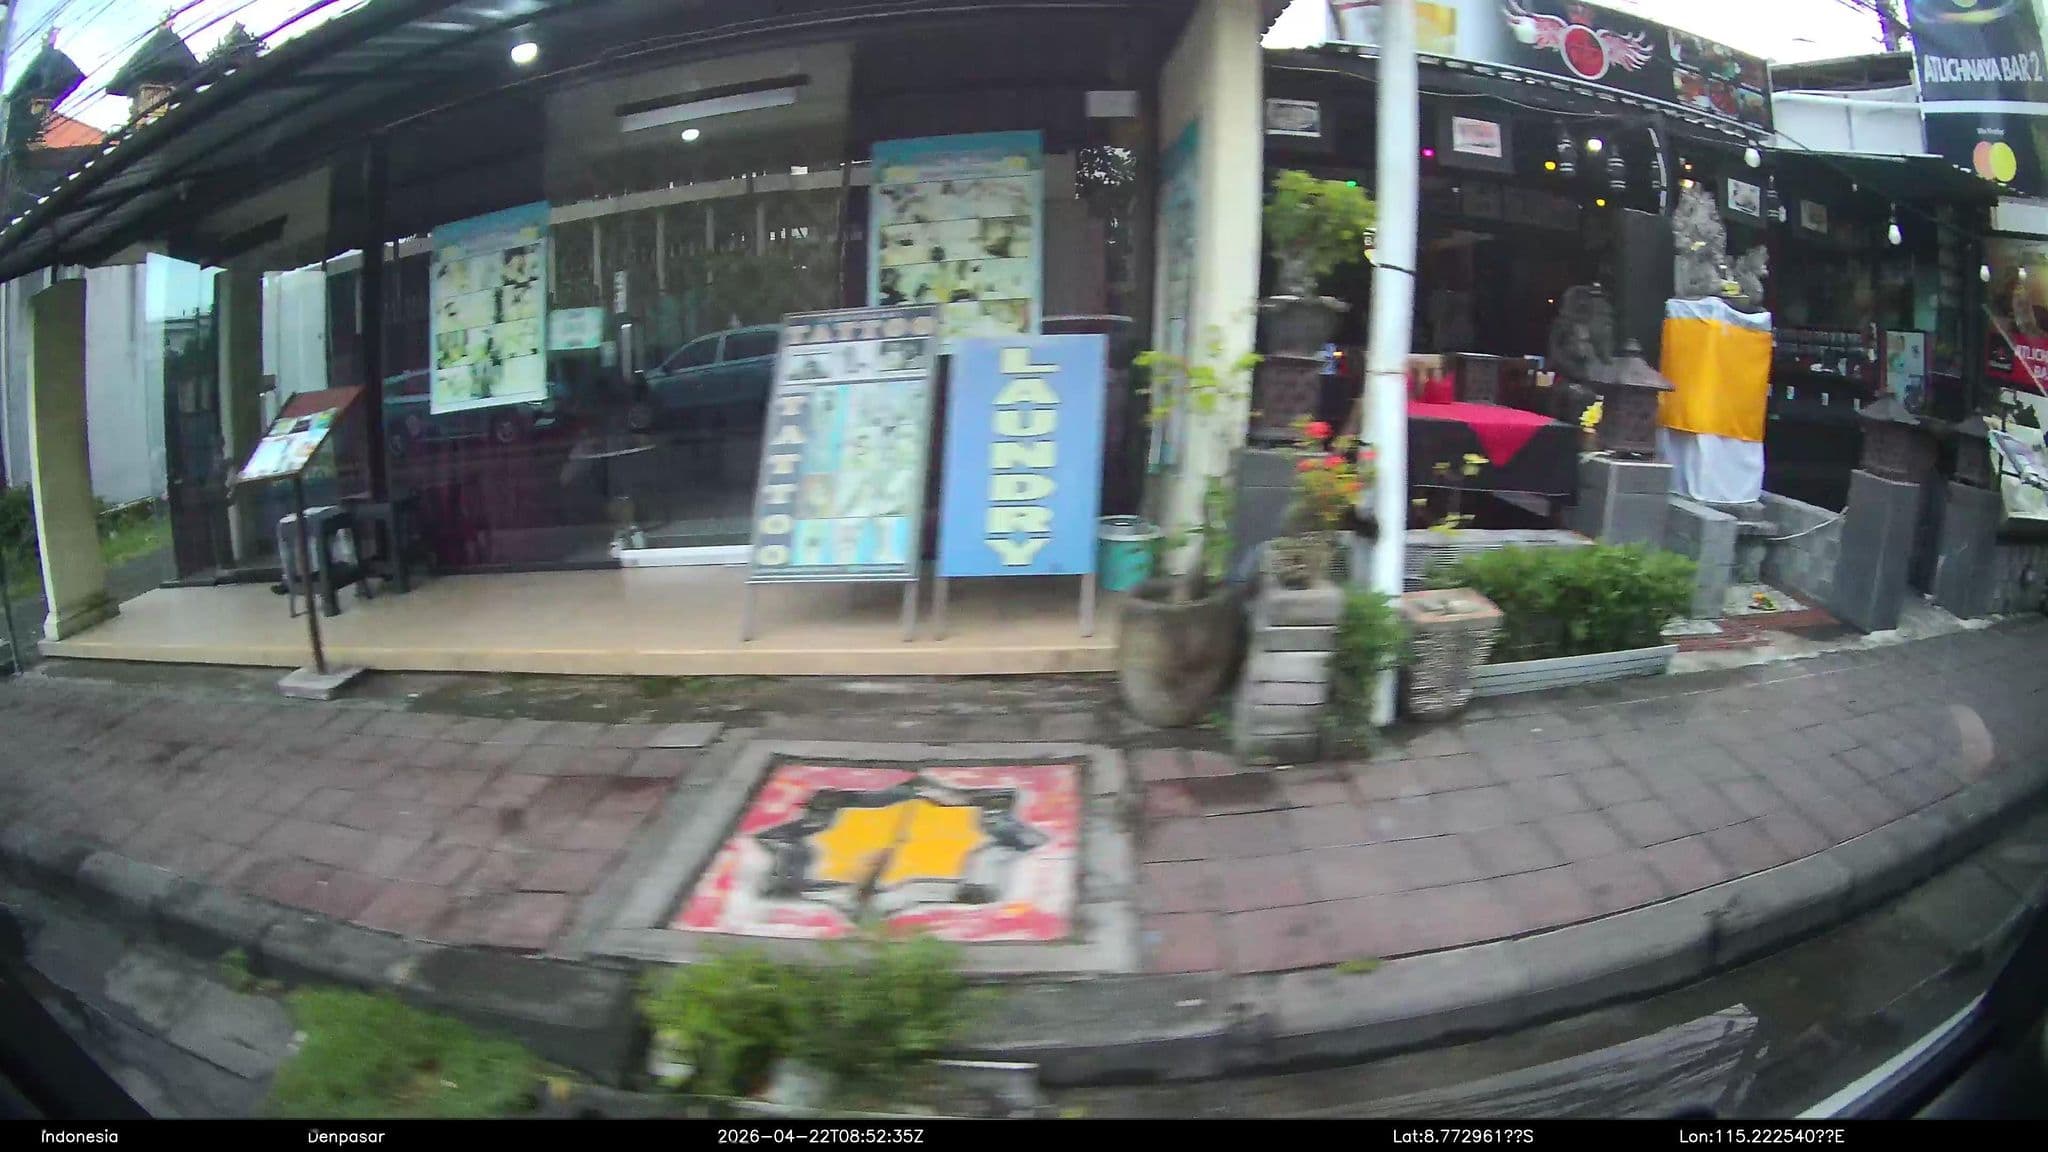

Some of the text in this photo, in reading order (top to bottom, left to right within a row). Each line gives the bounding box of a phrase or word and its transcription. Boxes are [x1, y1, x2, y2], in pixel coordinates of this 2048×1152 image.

[2001, 53, 2032, 82] BAR
[2029, 50, 2043, 82] 2
[785, 316, 937, 344] TATTOO
[757, 395, 808, 566] TATTOO
[984, 347, 1062, 567] LAUNDRY
